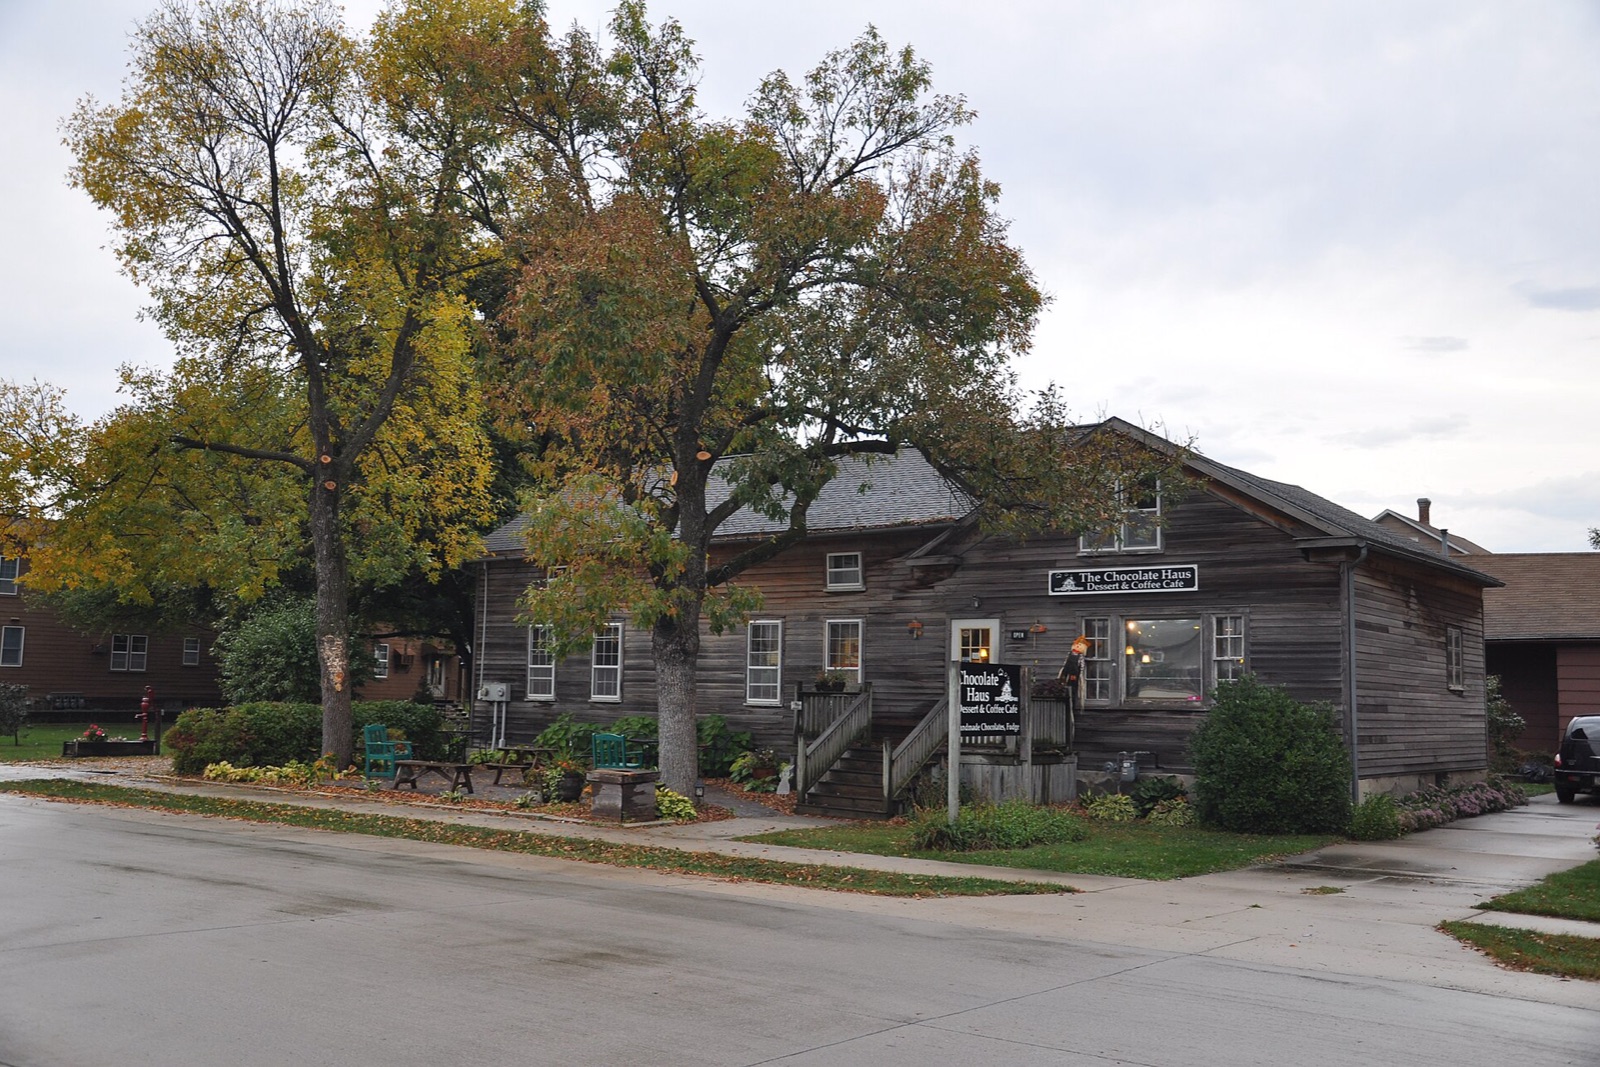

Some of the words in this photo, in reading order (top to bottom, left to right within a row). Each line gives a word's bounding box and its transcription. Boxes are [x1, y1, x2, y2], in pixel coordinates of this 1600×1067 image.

[1078, 571, 1102, 582] The
[1103, 570, 1159, 581] Chocolate
[1161, 569, 1192, 579] Haus
[1087, 582, 1120, 591] Dessert
[1120, 580, 1130, 590] &
[1131, 579, 1161, 590] Coffee
[966, 687, 990, 702] Haus
[979, 704, 986, 714] &
[986, 703, 1004, 714] Coffee
